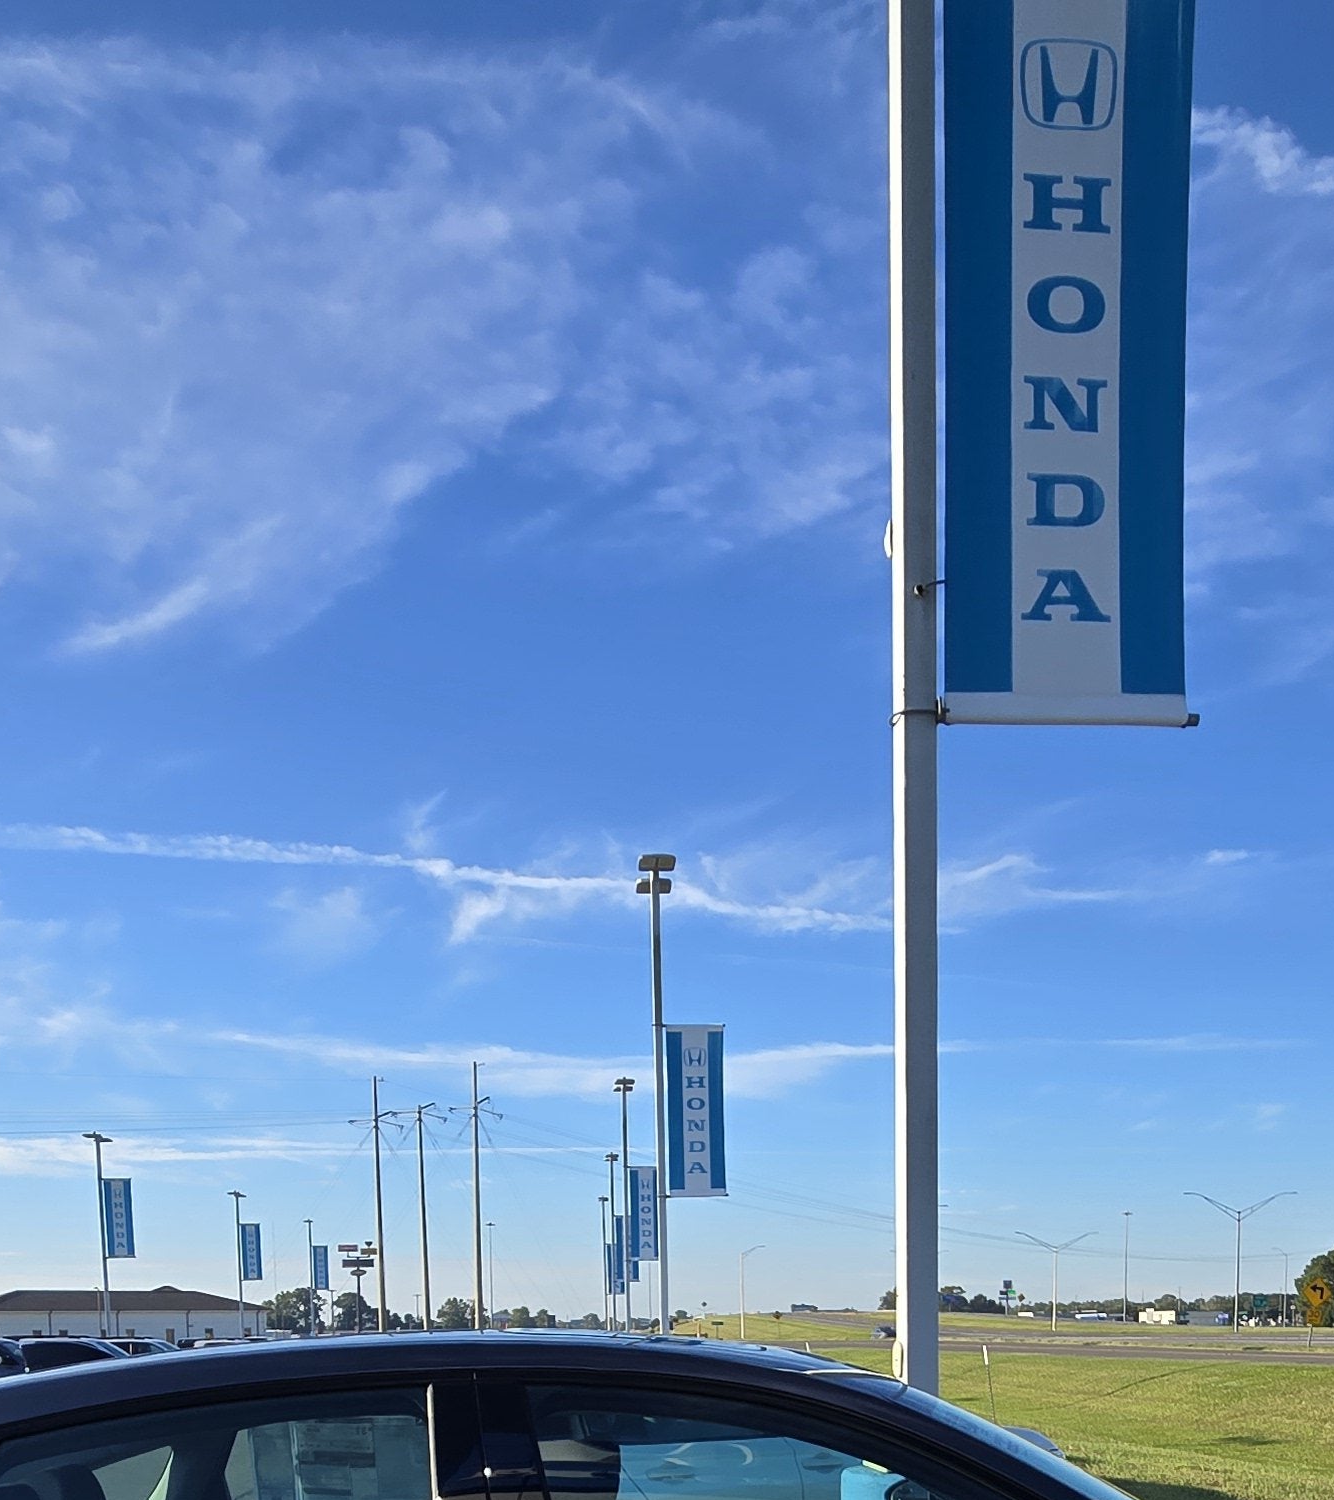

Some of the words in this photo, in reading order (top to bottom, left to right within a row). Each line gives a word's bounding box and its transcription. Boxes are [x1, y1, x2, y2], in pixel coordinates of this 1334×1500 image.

[1021, 172, 1112, 624] HONDA
[685, 1075, 708, 1175] HONDA
[114, 1202, 125, 1249] HONDA
[641, 1194, 652, 1249] HONDA
